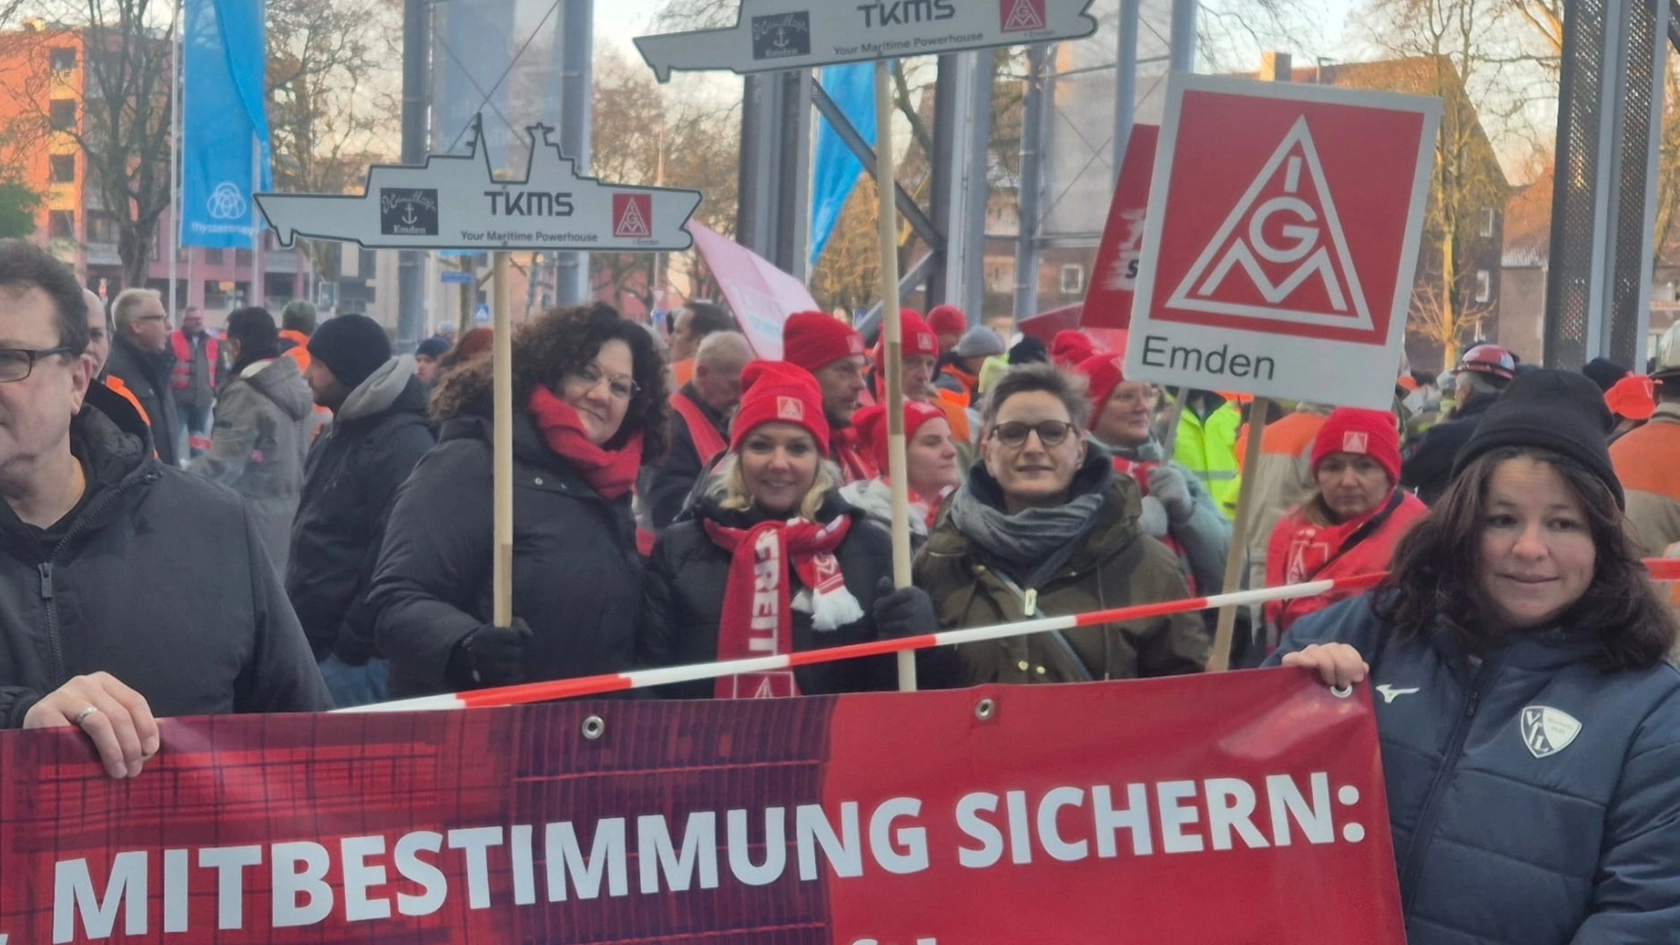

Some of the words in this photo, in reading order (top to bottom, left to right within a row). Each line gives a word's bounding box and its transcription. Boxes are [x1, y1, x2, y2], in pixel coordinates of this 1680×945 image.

[857, 0, 956, 28] TKMS
[833, 45, 858, 56] Your
[861, 40, 911, 53] Maritime
[914, 32, 984, 47] Powerhouse
[484, 191, 574, 217] TKMS
[461, 231, 484, 241] Your
[487, 231, 533, 241] Maritime
[536, 231, 599, 242] Powerhouse
[1141, 335, 1275, 380] Emden
[52, 797, 929, 944] MITBESTIMMUNG
[955, 772, 1366, 868] SICHERN:
